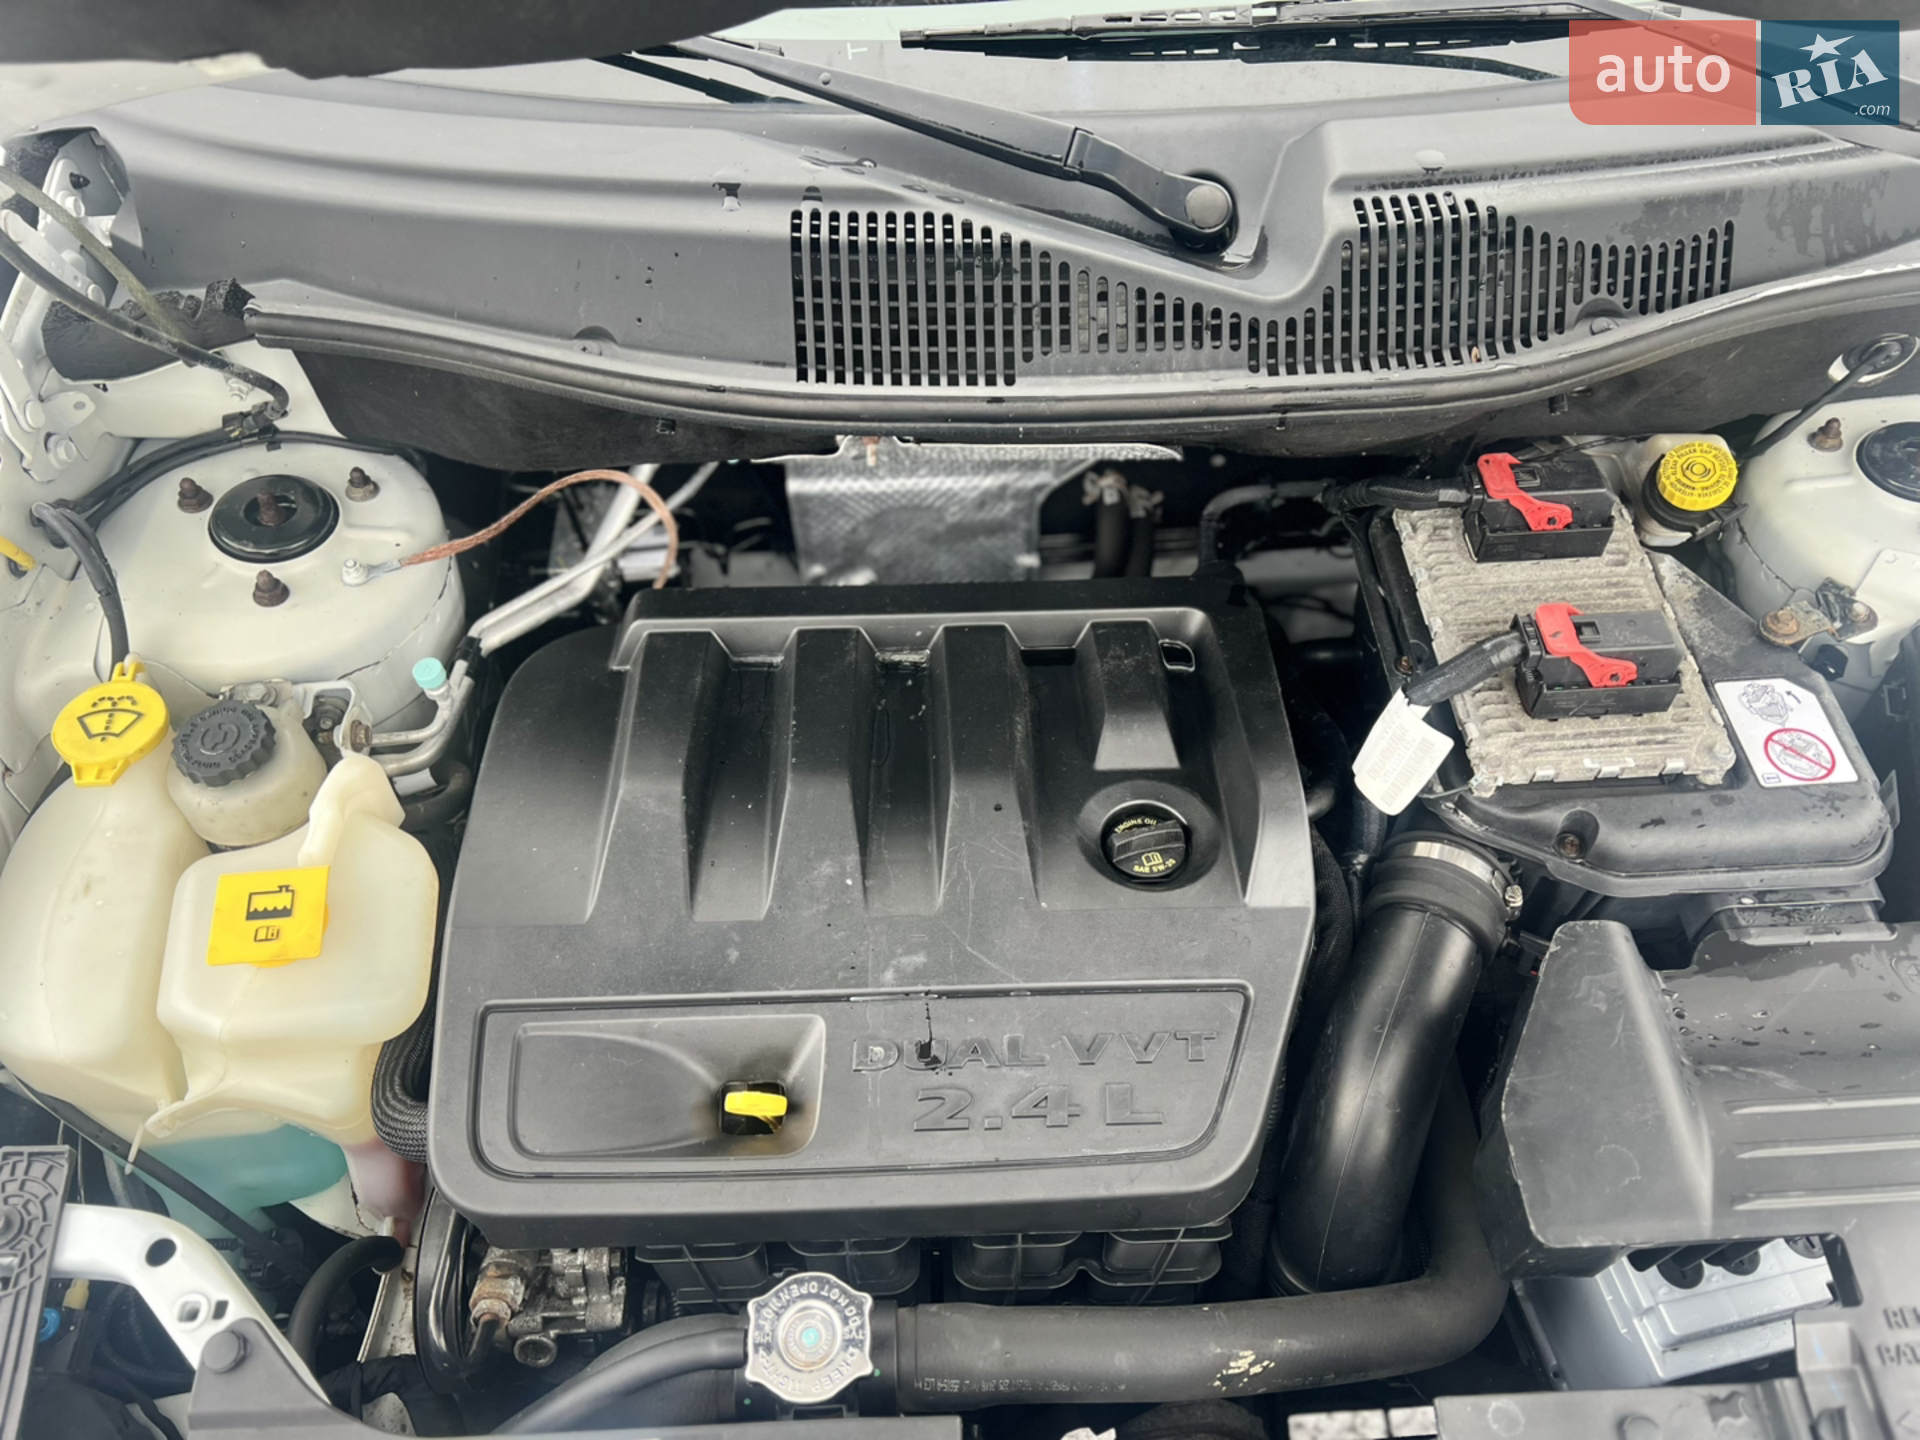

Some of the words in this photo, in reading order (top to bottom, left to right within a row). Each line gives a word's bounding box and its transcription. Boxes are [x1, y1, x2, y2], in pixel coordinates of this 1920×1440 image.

[1114, 818, 1143, 834] ENGINE
[1133, 864, 1150, 873] SAE
[852, 1033, 1050, 1073] DUAL
[1060, 1030, 1218, 1065] VVT
[913, 1083, 1081, 1132] 2.4
[1105, 1082, 1163, 1126] L
[820, 1284, 850, 1307] NOT
